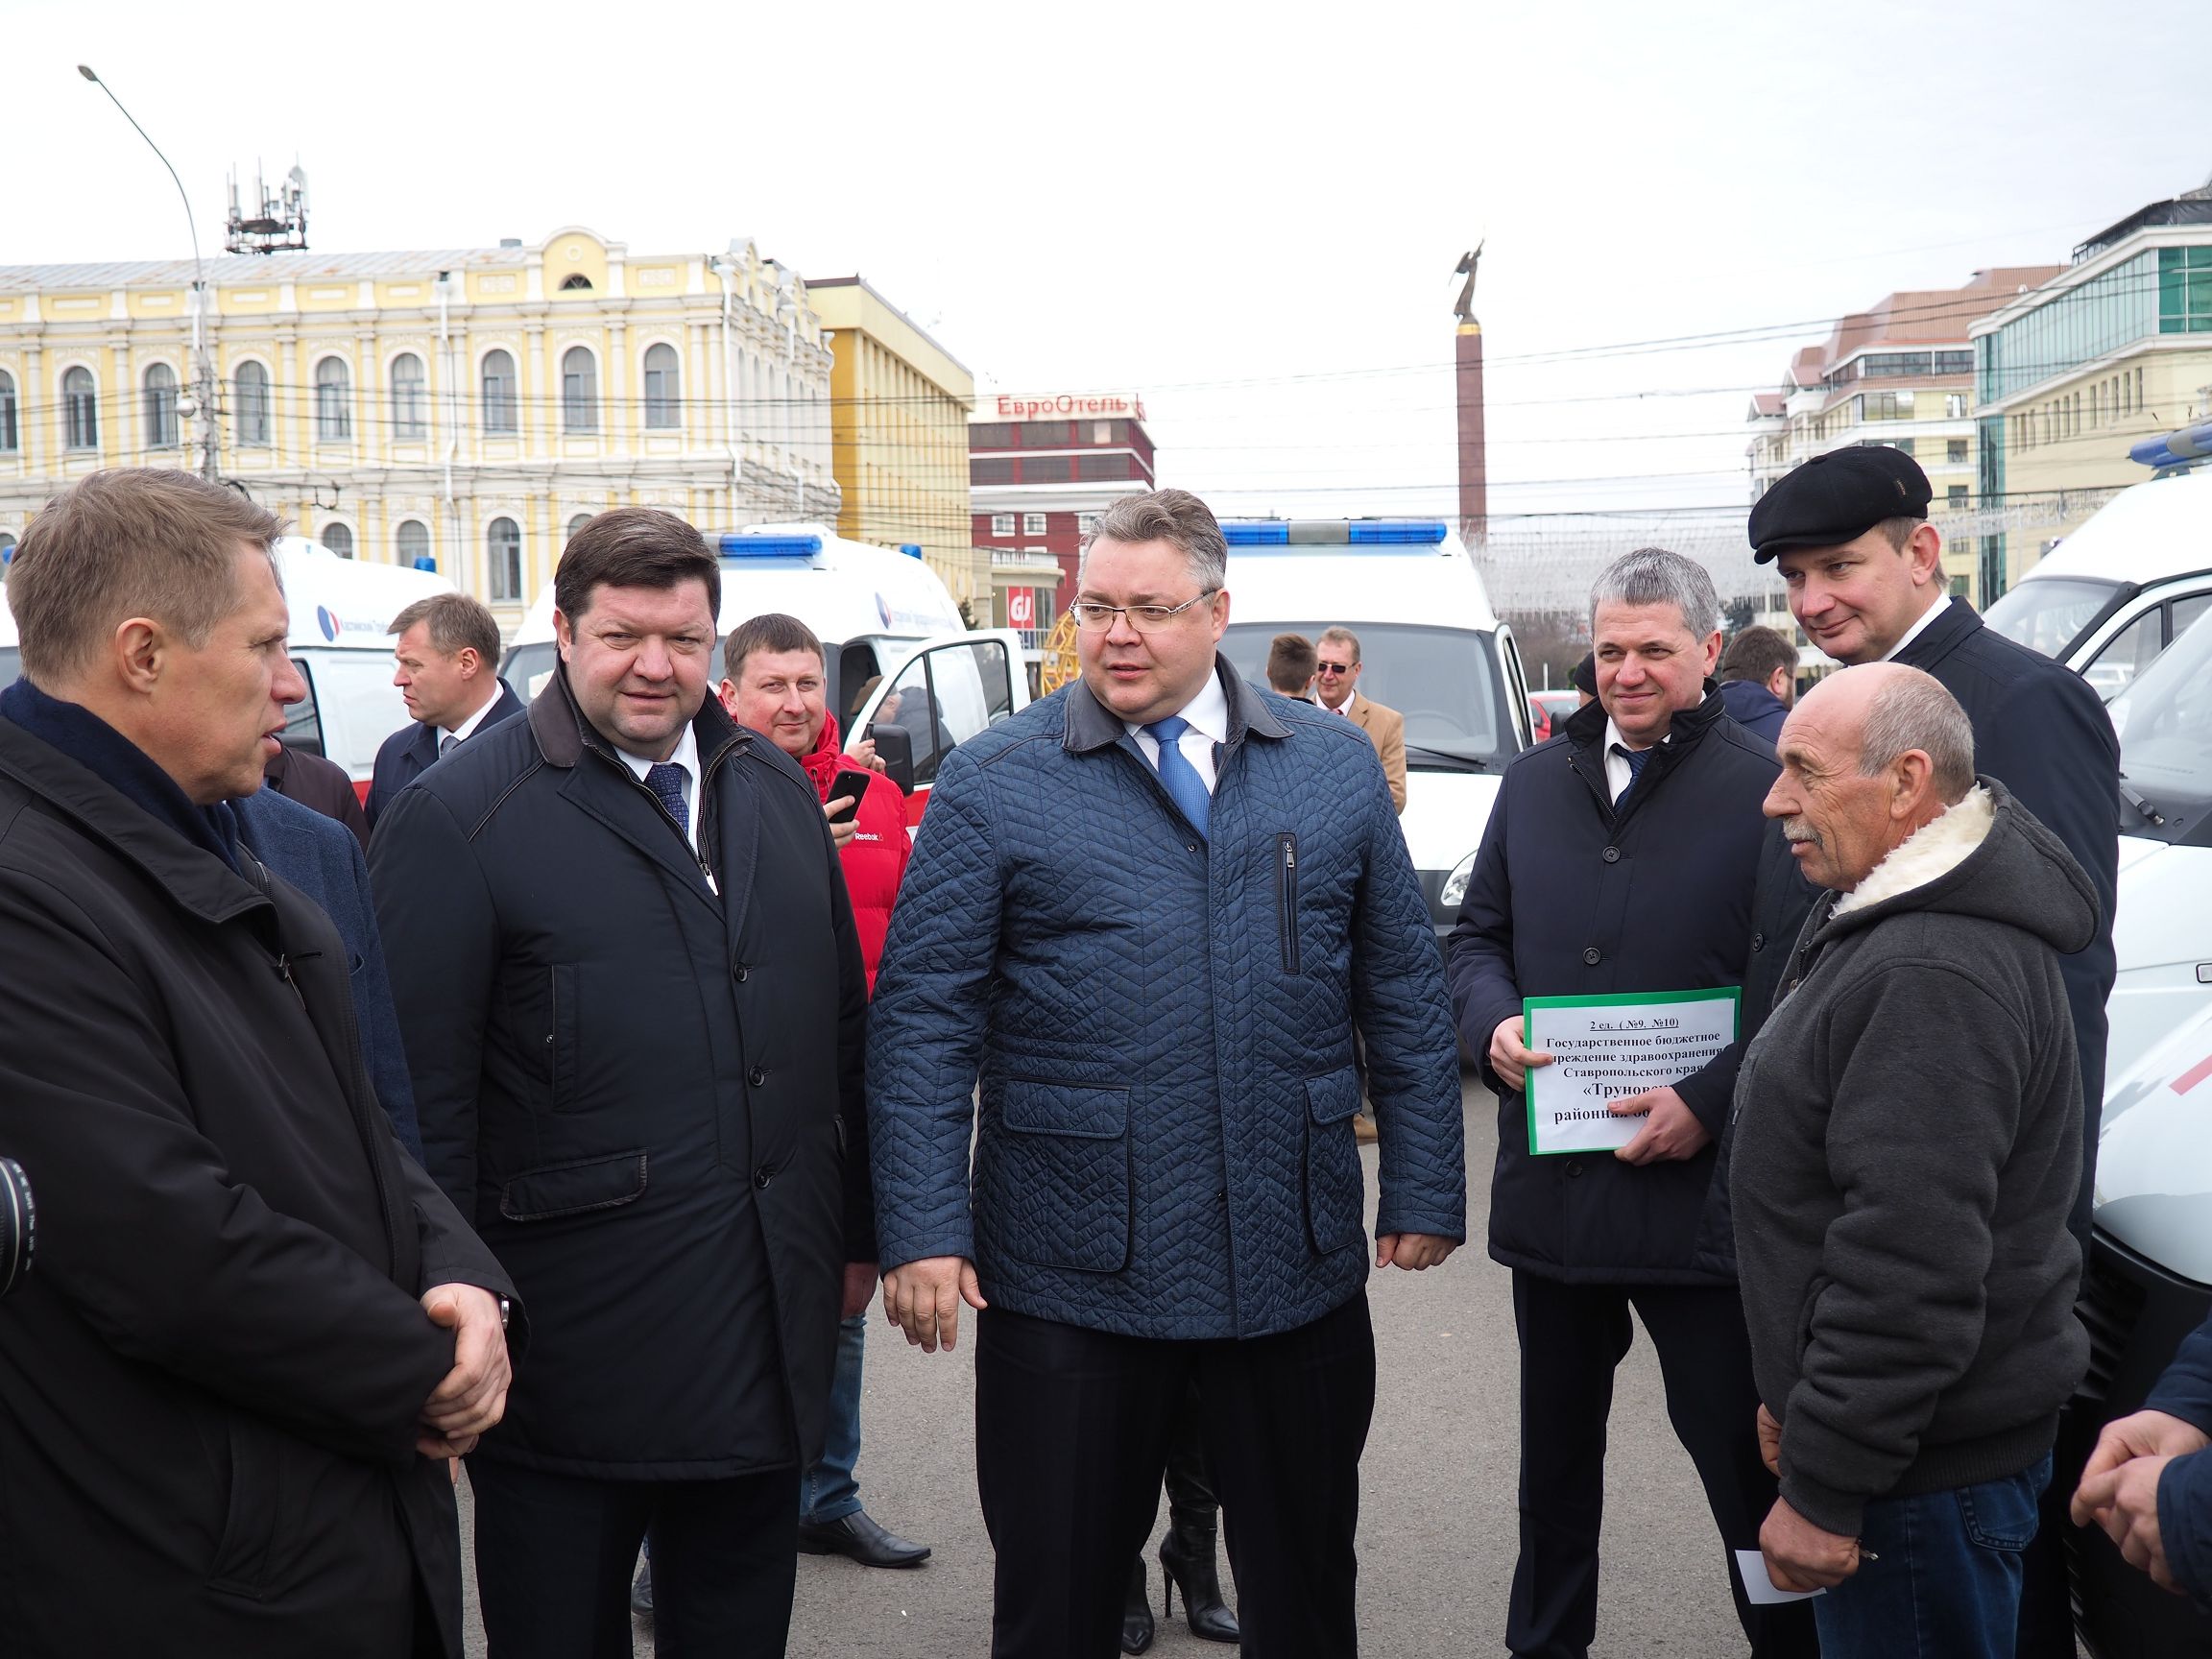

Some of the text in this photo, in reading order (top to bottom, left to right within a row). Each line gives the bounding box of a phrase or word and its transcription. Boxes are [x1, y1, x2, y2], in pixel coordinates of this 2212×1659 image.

[997, 395, 1128, 419] ЕвроОтель
[855, 832, 878, 841] Reebok
[1590, 1021, 1596, 1029] 2
[1651, 1018, 1679, 1028] №10)
[1547, 1032, 1720, 1049] Государственное бюджетное
[1620, 1047, 1722, 1065] здравоохранения
[1564, 1067, 1671, 1079] Ставропольского
